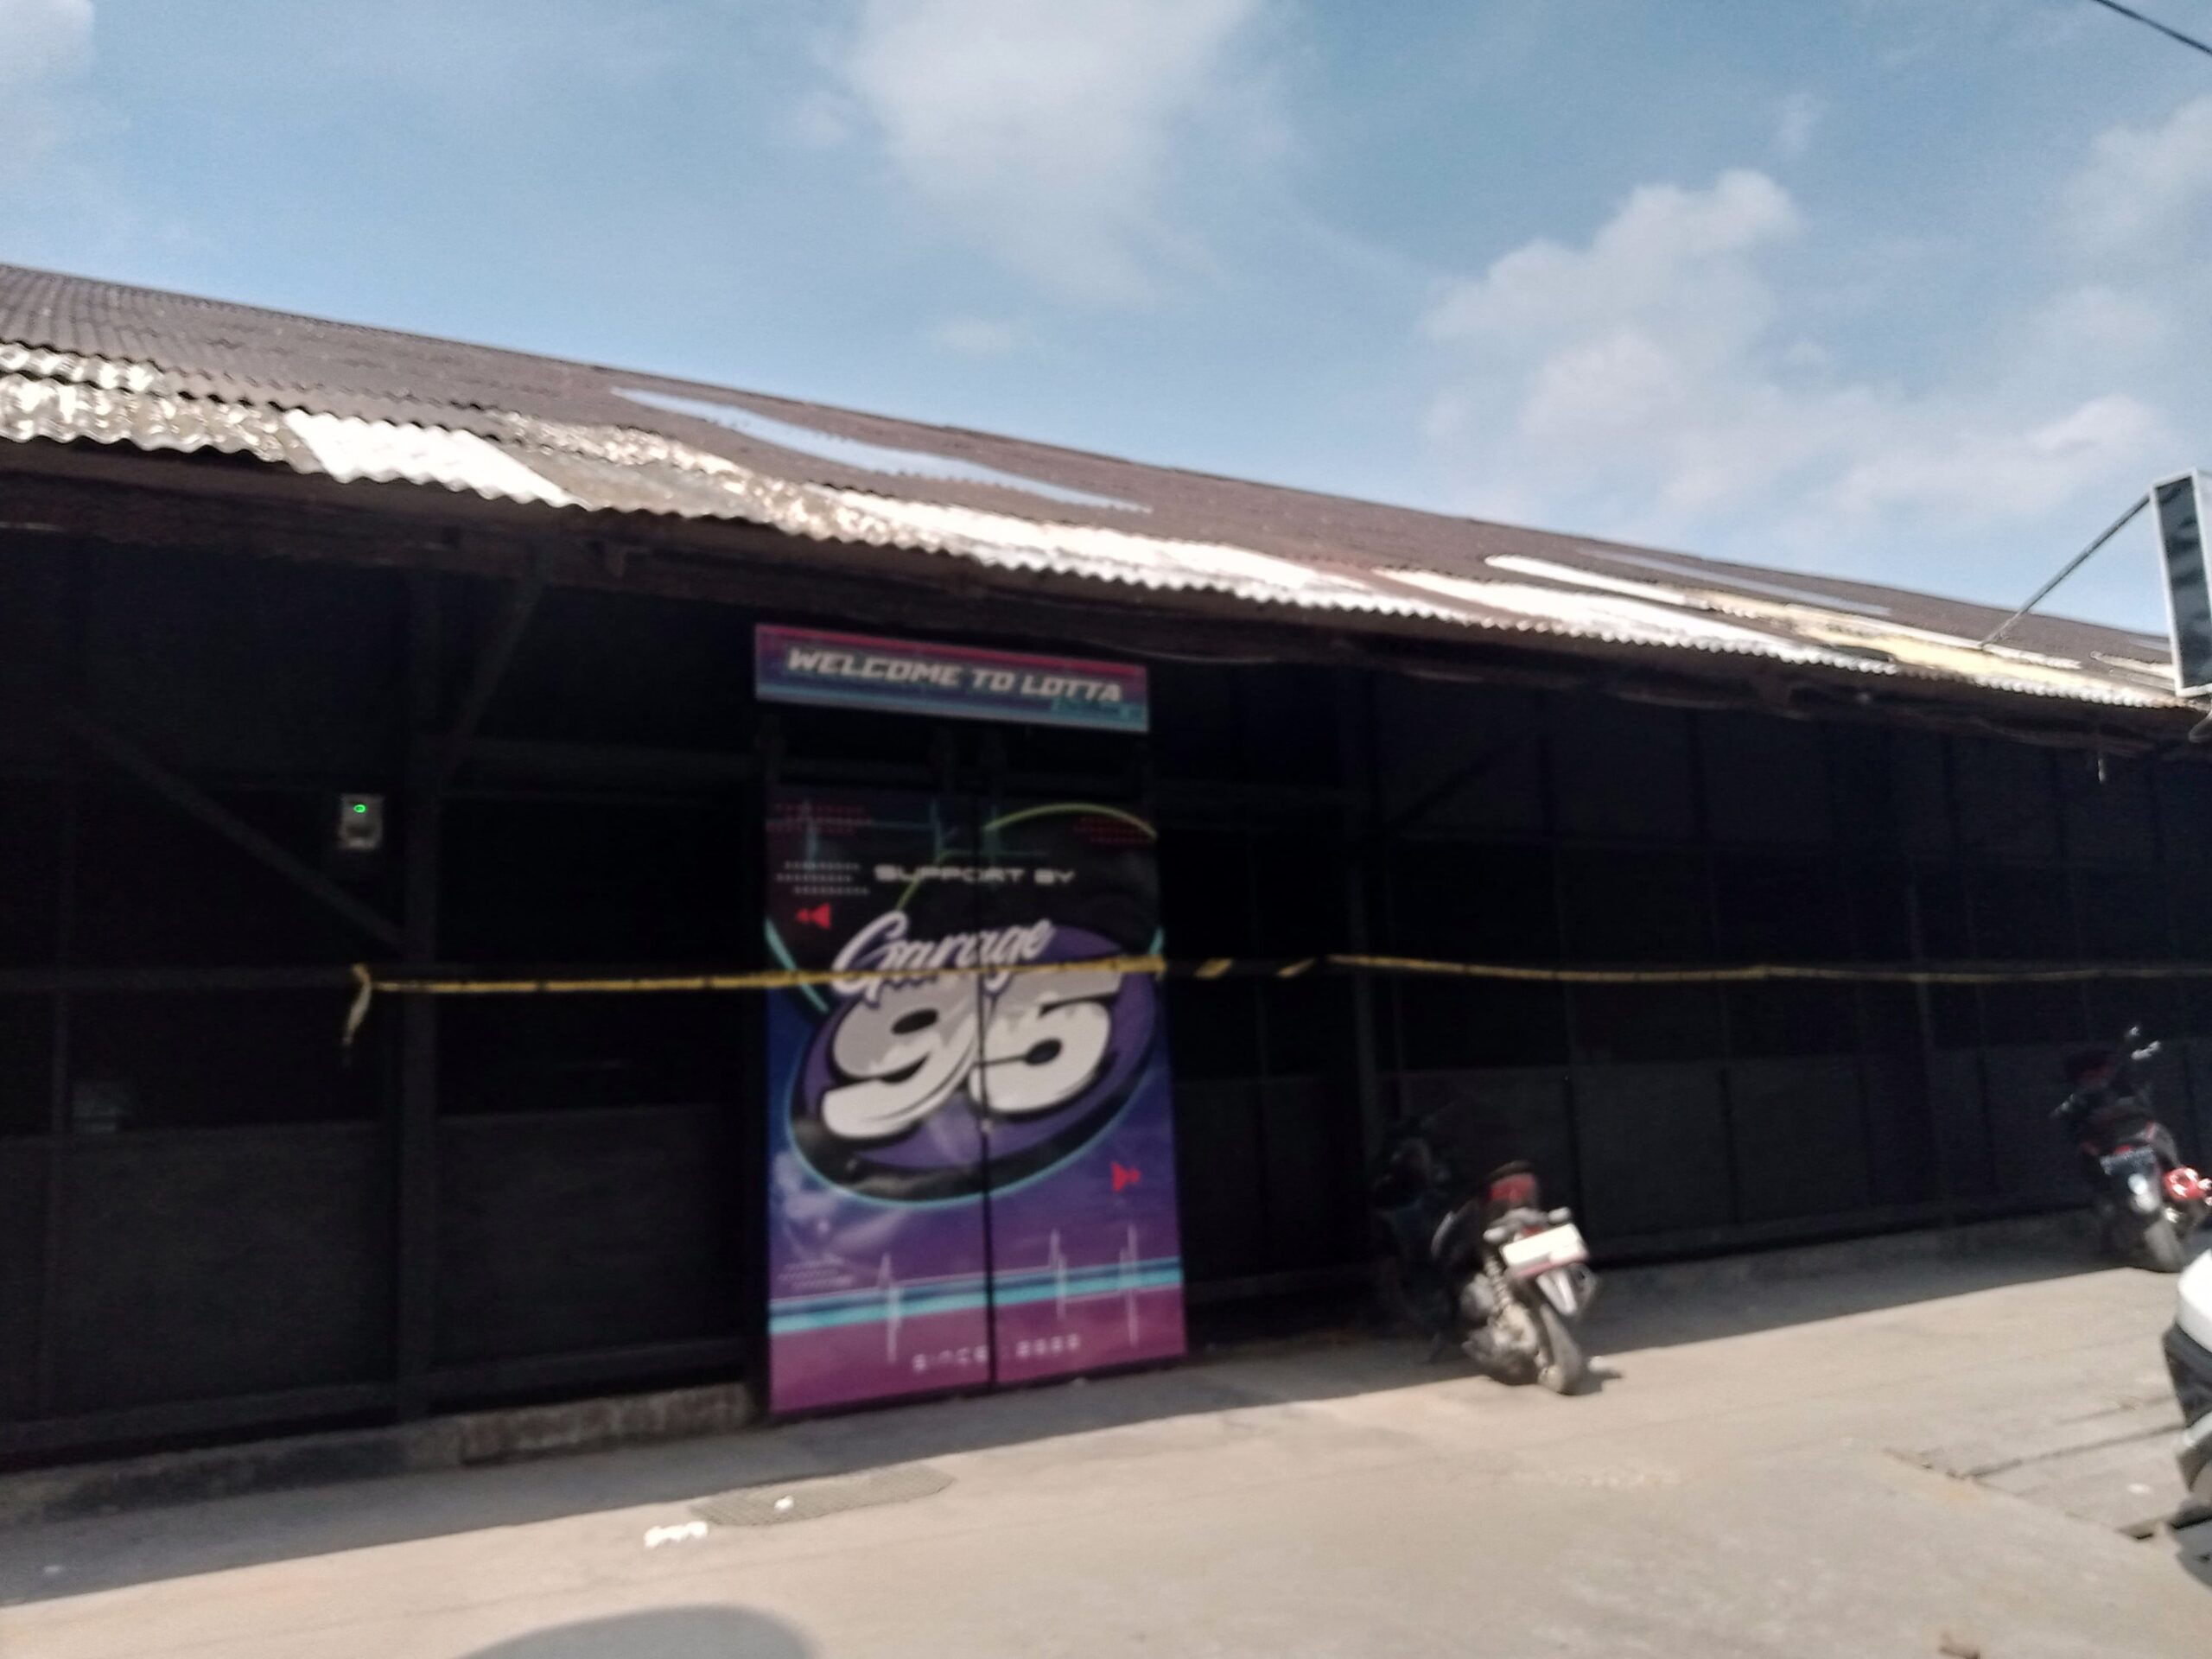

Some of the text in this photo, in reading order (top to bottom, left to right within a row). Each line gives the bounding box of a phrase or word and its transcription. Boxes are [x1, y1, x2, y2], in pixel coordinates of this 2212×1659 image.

[787, 647, 1122, 702] WELCOME TO LOTTA
[873, 865, 1075, 885] SUPPORT BY
[829, 910, 1056, 1007] Garage
[821, 968, 1123, 1139] 95
